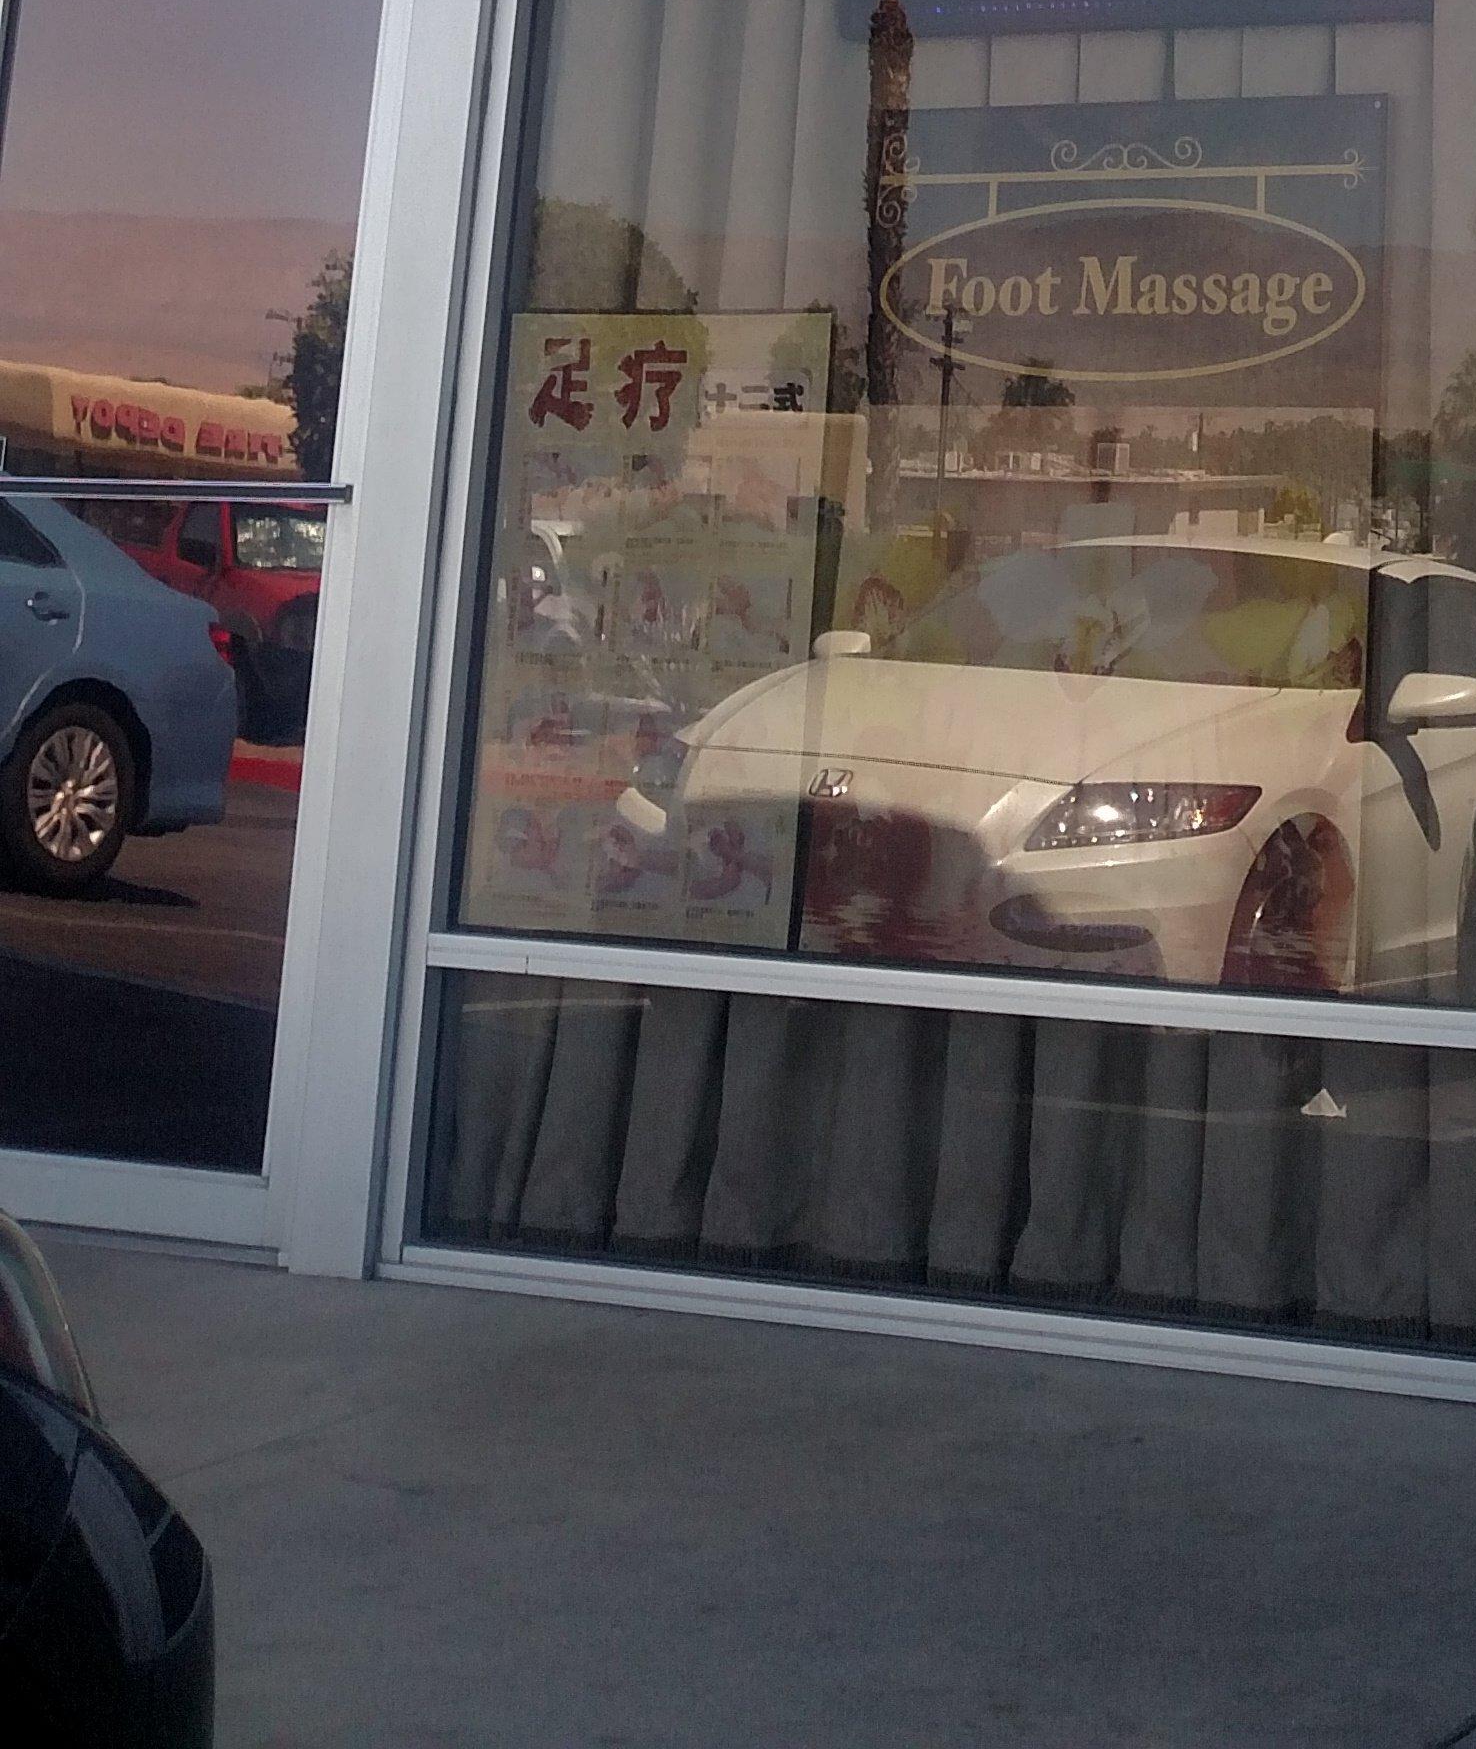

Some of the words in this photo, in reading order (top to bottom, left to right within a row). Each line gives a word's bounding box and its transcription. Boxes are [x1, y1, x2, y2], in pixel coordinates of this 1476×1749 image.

[925, 256, 1061, 332] Foot
[1079, 255, 1335, 337] Massage
[528, 337, 688, 433] 足疗
